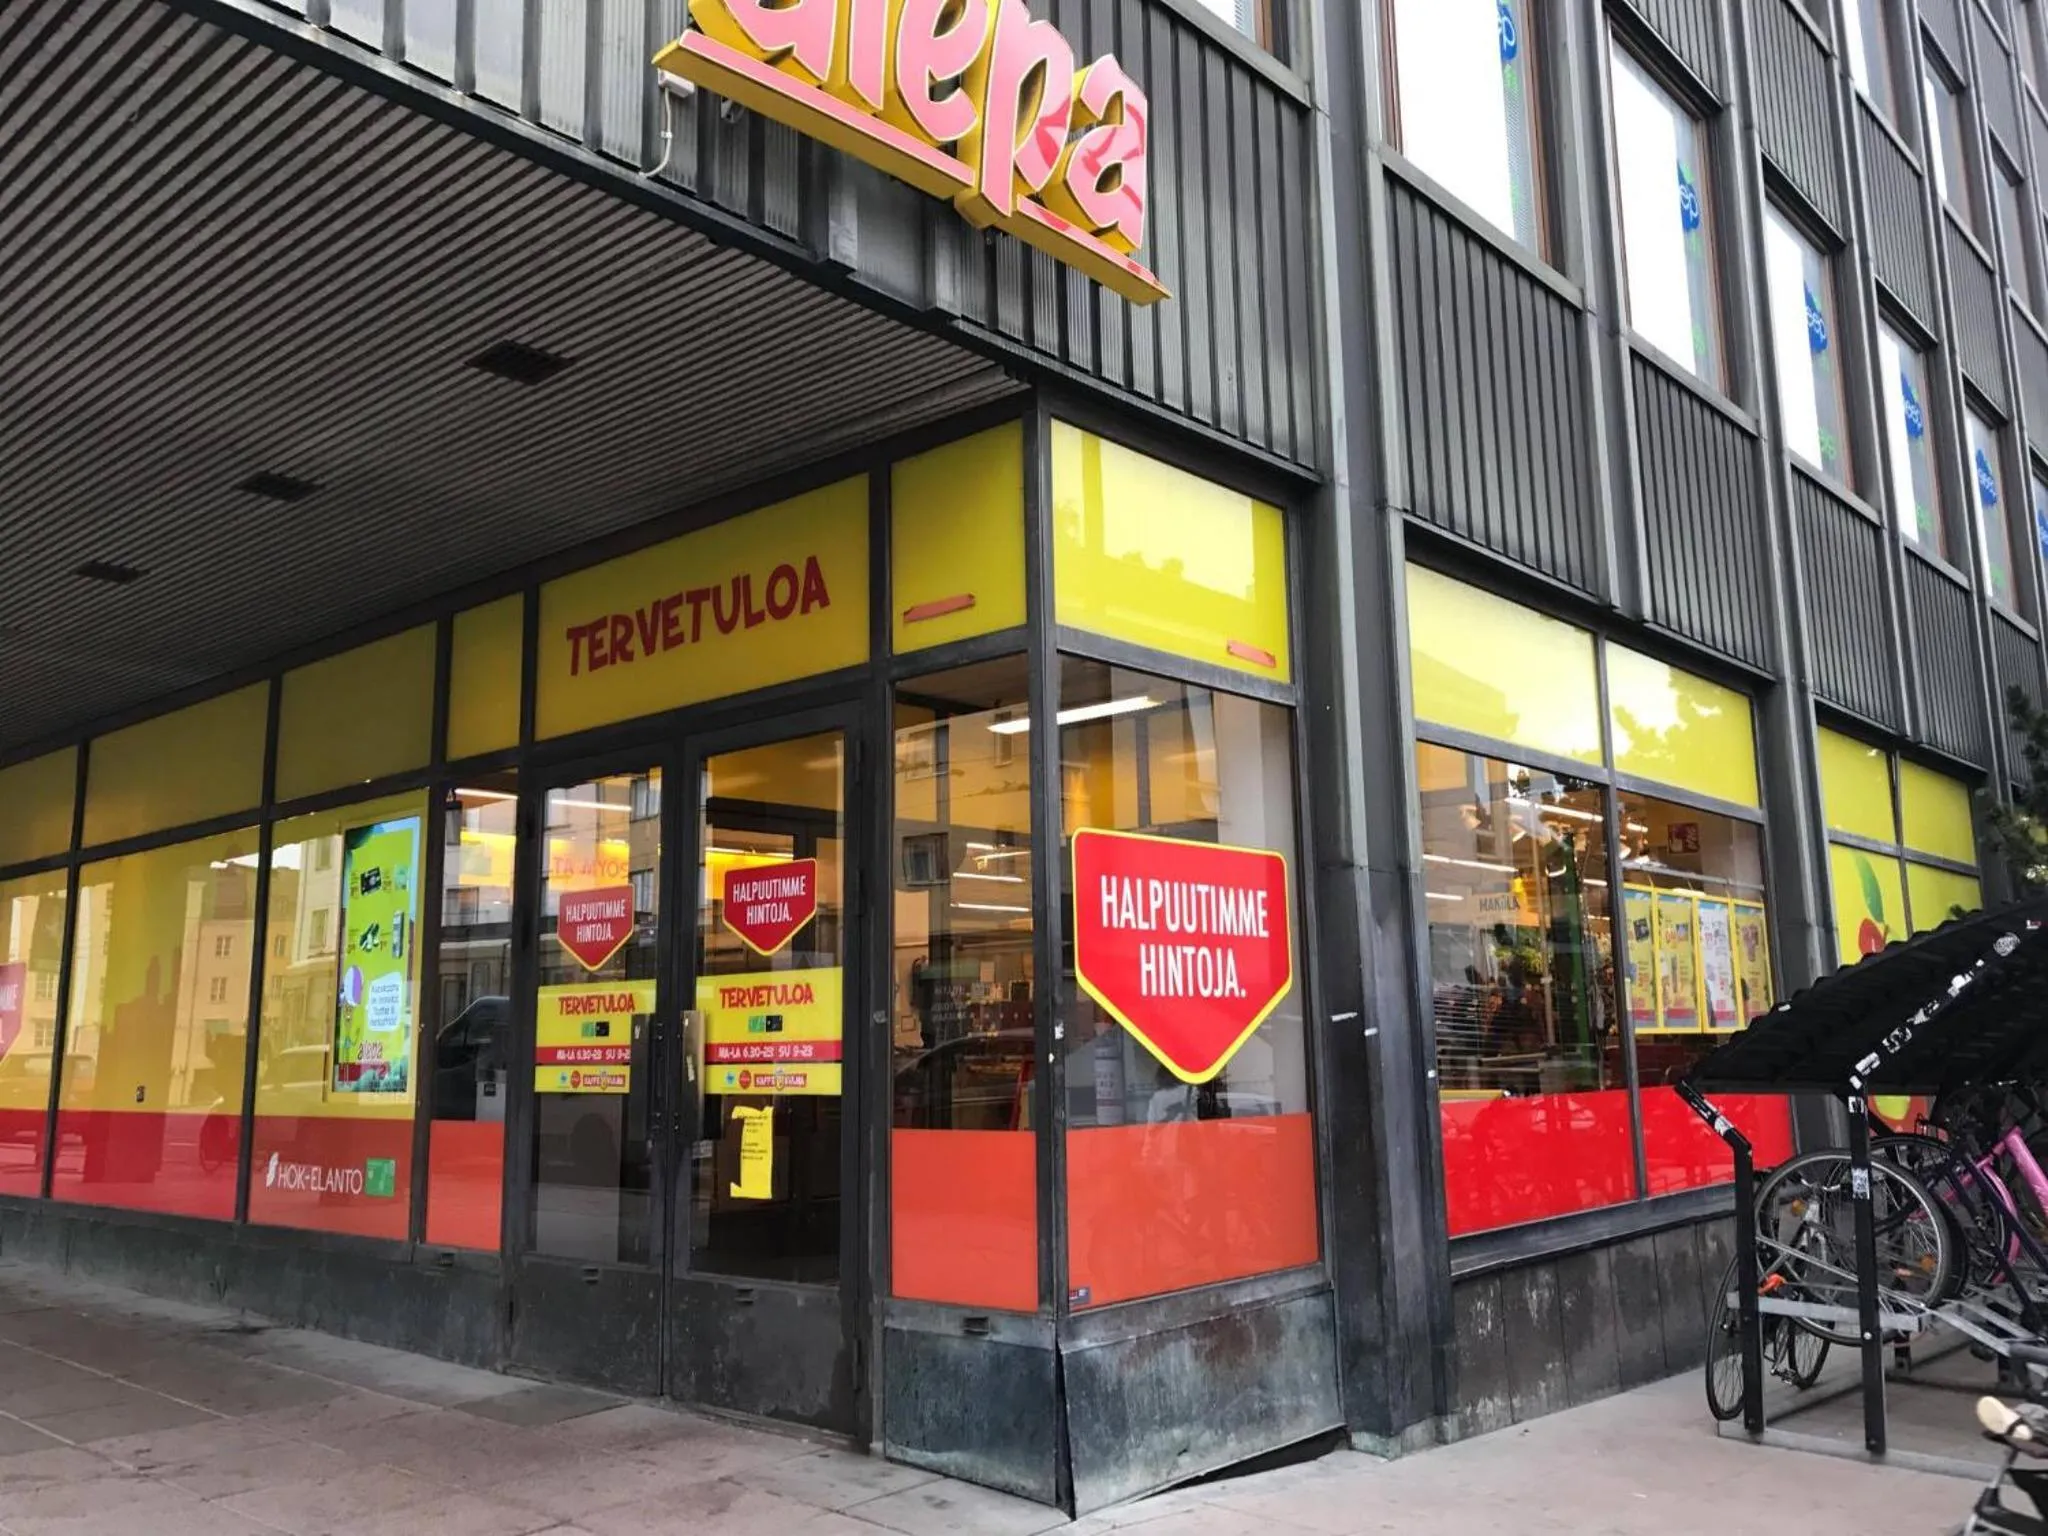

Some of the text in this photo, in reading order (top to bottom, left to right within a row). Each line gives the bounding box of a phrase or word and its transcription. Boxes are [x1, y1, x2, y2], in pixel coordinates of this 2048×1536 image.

[566, 555, 831, 676] TERVETULOA
[733, 875, 807, 903] HALPUUTIMME
[566, 900, 626, 922] HALPUUTIMME
[746, 902, 793, 926] HINTOJA.
[1101, 874, 1269, 938] HALPUUTIMME
[577, 923, 614, 943] HINTOJA.
[1140, 943, 1247, 998] HINTOJA.
[558, 993, 636, 1016] TERVETULOA
[719, 982, 815, 1009] TERVETULOA
[278, 1163, 363, 1195] HOK-ELANTO
